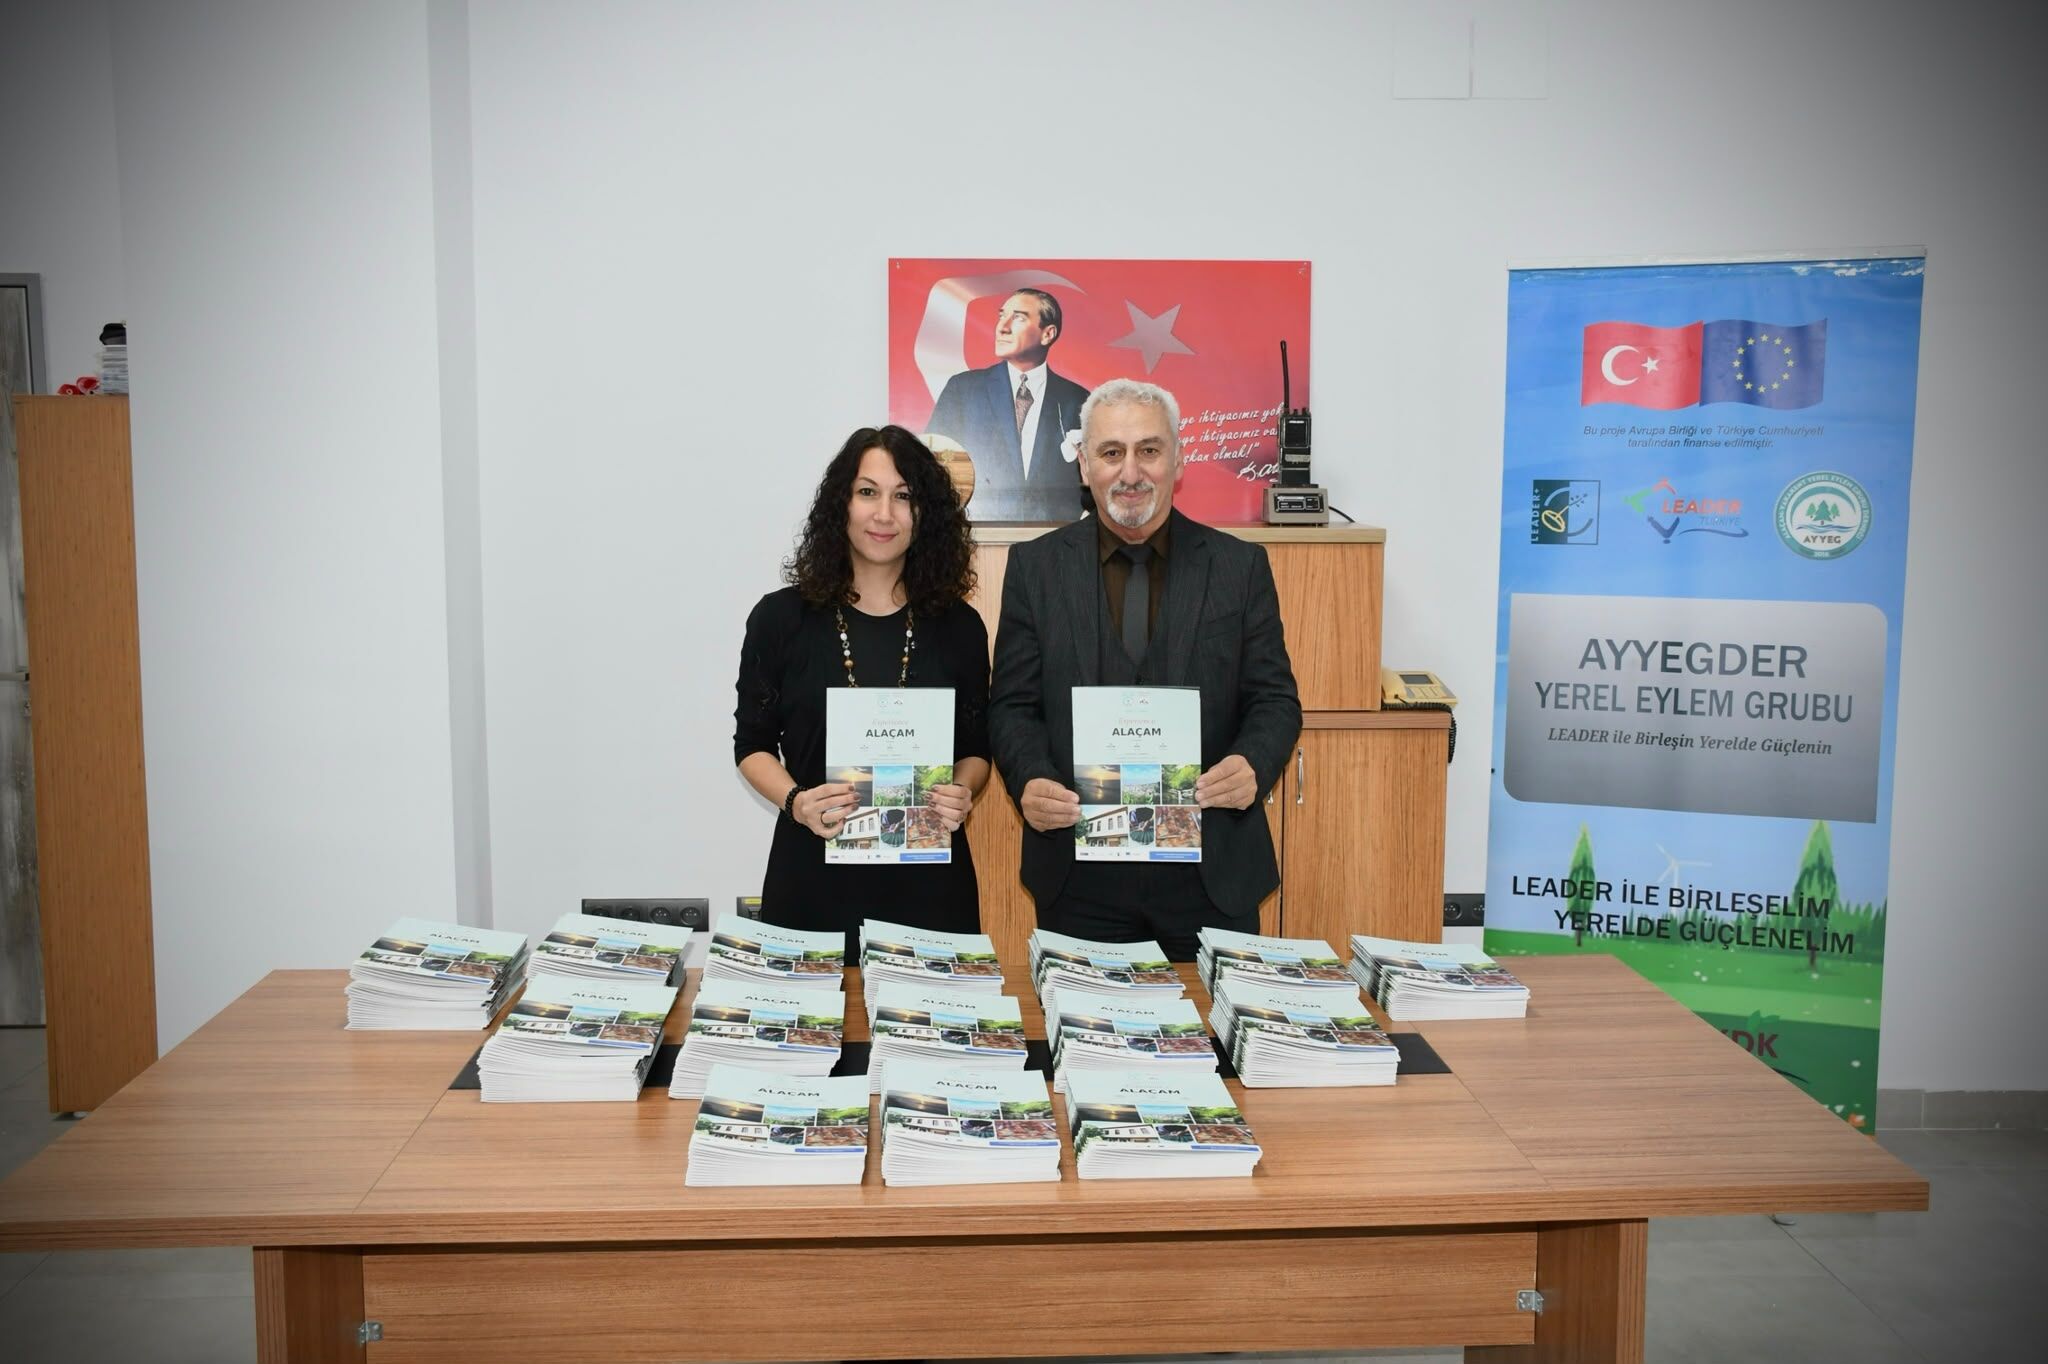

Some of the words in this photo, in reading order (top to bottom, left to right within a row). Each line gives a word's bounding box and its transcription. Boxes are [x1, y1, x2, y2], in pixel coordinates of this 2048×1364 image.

[1178, 416, 1194, 430] ye
[1584, 426, 1598, 435] Bu
[1600, 426, 1625, 438] proje
[1629, 425, 1665, 437] Avrupa
[1669, 425, 1697, 438] Birliği
[1700, 427, 1712, 435] ve
[1717, 425, 1755, 438] Türkiye
[1758, 425, 1824, 438] Cumhuriyeti
[1628, 437, 1681, 448] tarafından
[1683, 437, 1721, 448] finanse
[1724, 437, 1774, 449] edilmiştir.
[1183, 449, 1210, 466] şkan
[1662, 499, 1742, 514] LEADER
[1578, 638, 1808, 678] AYYEGDER
[1535, 681, 1626, 712] YEREL
[1636, 686, 1734, 717] EYLEM
[1744, 691, 1853, 723] GRUBU
[865, 728, 915, 740] ALAÇAM
[1112, 727, 1162, 738] ALAÇAM
[1548, 728, 1609, 743] LEADER
[1612, 730, 1631, 744] ile
[1635, 732, 1694, 750] Birleşin
[1700, 735, 1757, 751] Yerelde
[1761, 738, 1832, 756] Güçlenin
[1512, 876, 1612, 901] LEADER
[1622, 879, 1659, 906] İLE
[1668, 884, 1830, 920] BİRLEŞELİM
[1554, 909, 1671, 939] YERELDE
[1679, 918, 1854, 955] GÜÇLENELİM
[1721, 1028, 1778, 1059] DK
